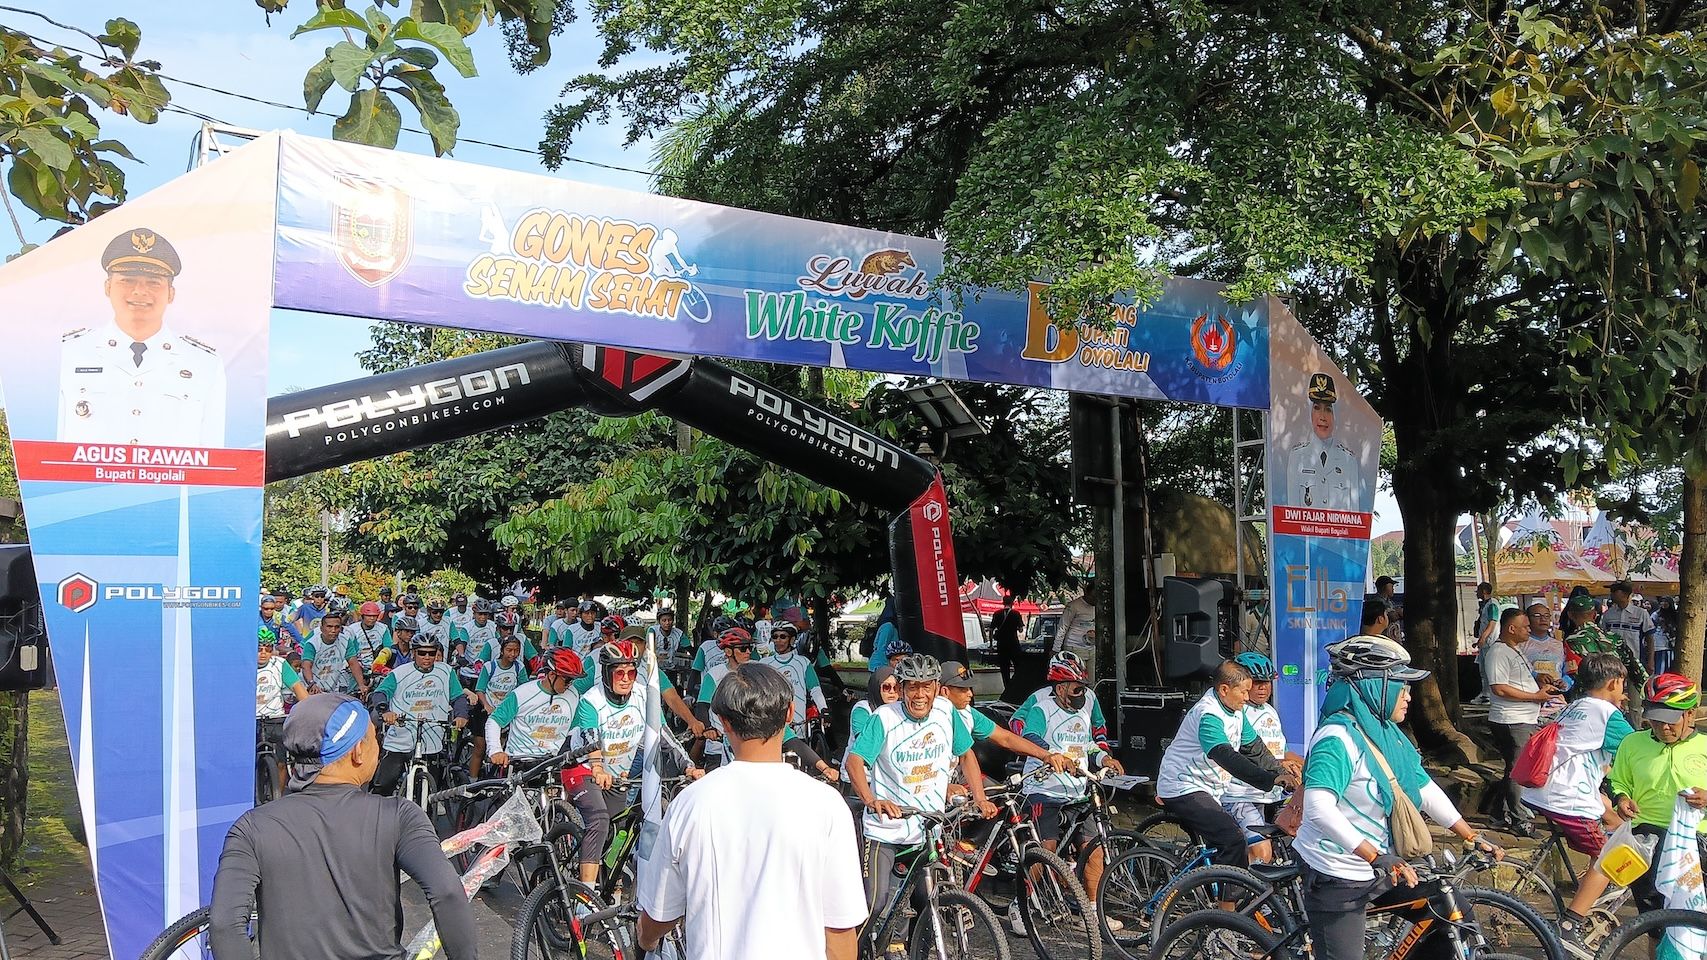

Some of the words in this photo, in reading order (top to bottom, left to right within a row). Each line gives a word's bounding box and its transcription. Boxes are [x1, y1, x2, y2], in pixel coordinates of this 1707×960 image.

[511, 209, 658, 276] GOWES
[465, 257, 590, 304] SENAM
[588, 273, 690, 318] SEHAT
[798, 254, 929, 298] Luwak
[745, 290, 863, 342] White
[869, 302, 981, 362] Koffie
[283, 362, 532, 440] POLYGON
[323, 395, 507, 445] POLYGONBIKES.COM
[729, 375, 900, 470] POLYGON
[72, 444, 127, 465] AGUS
[131, 446, 210, 467] IRAWAN
[747, 408, 877, 473] POLYGONBIKES.COM
[95, 467, 136, 482] Bupati
[138, 468, 186, 483] Boyolali
[1285, 509, 1301, 520] DWI
[1302, 511, 1326, 522] FAJAR
[1326, 513, 1363, 525] NIRWANA
[1315, 526, 1330, 535] Bupati
[931, 526, 949, 606] POLYGON
[1285, 564, 1348, 613] Ella
[105, 585, 242, 600] POLYGON
[1288, 617, 1312, 629] SKIN
[896, 750, 923, 762] White
